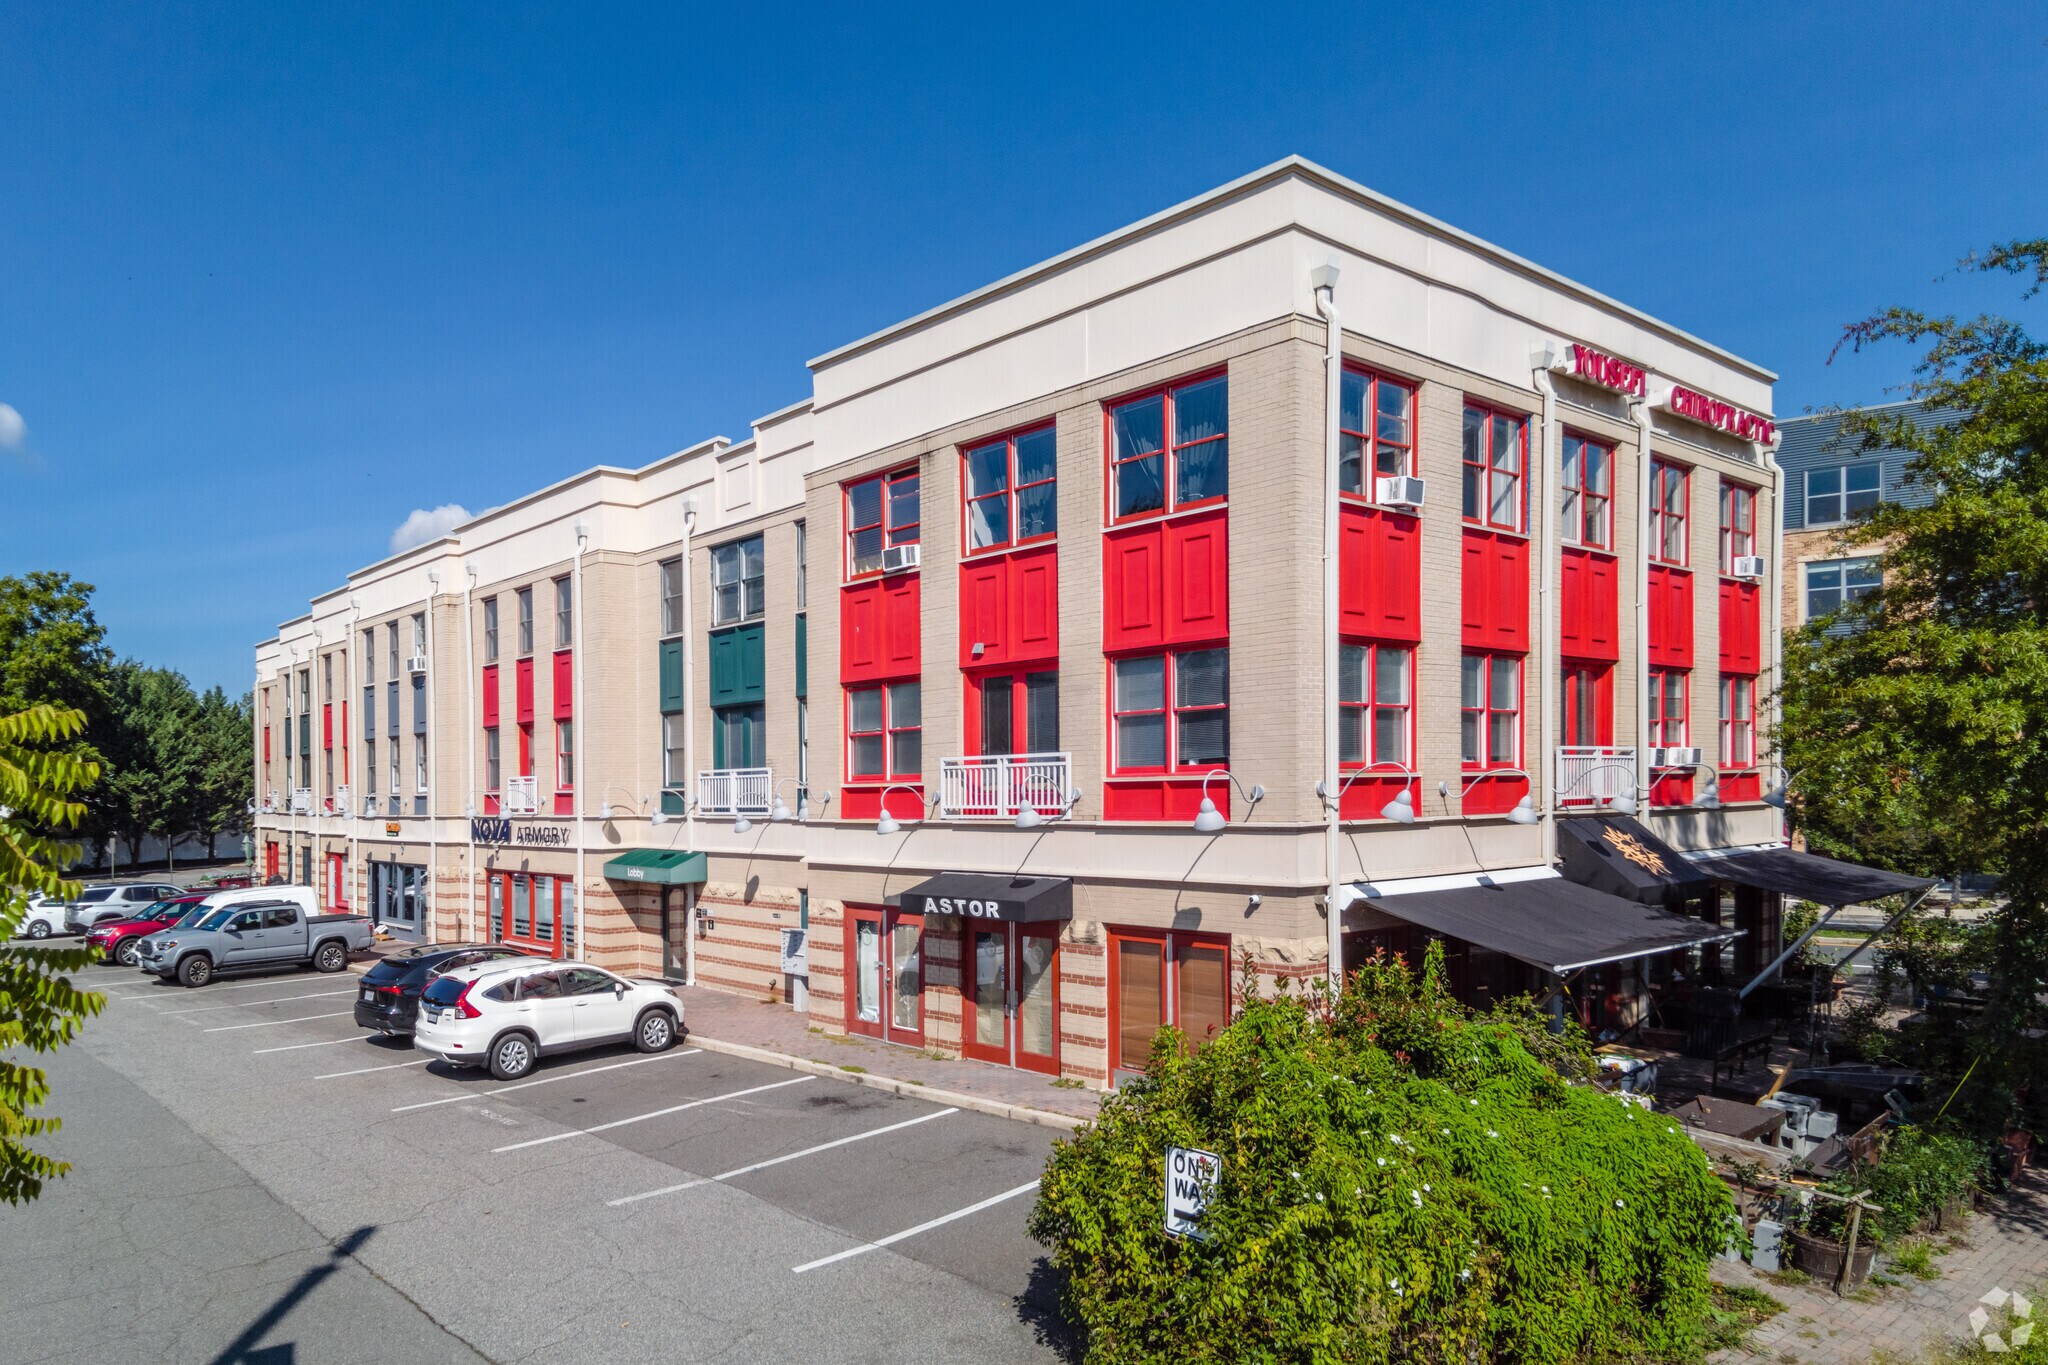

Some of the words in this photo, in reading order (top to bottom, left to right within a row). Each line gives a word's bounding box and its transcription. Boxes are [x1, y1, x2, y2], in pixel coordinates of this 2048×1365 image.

[1572, 343, 1646, 398] YOUSEFI
[1671, 385, 1775, 446] CHIROPRACTIC
[471, 818, 511, 842] NOVA
[516, 826, 568, 844] ARMORY
[627, 867, 645, 880] Lobby
[924, 897, 1000, 919] ASTOR
[1174, 1177, 1213, 1204] WA
